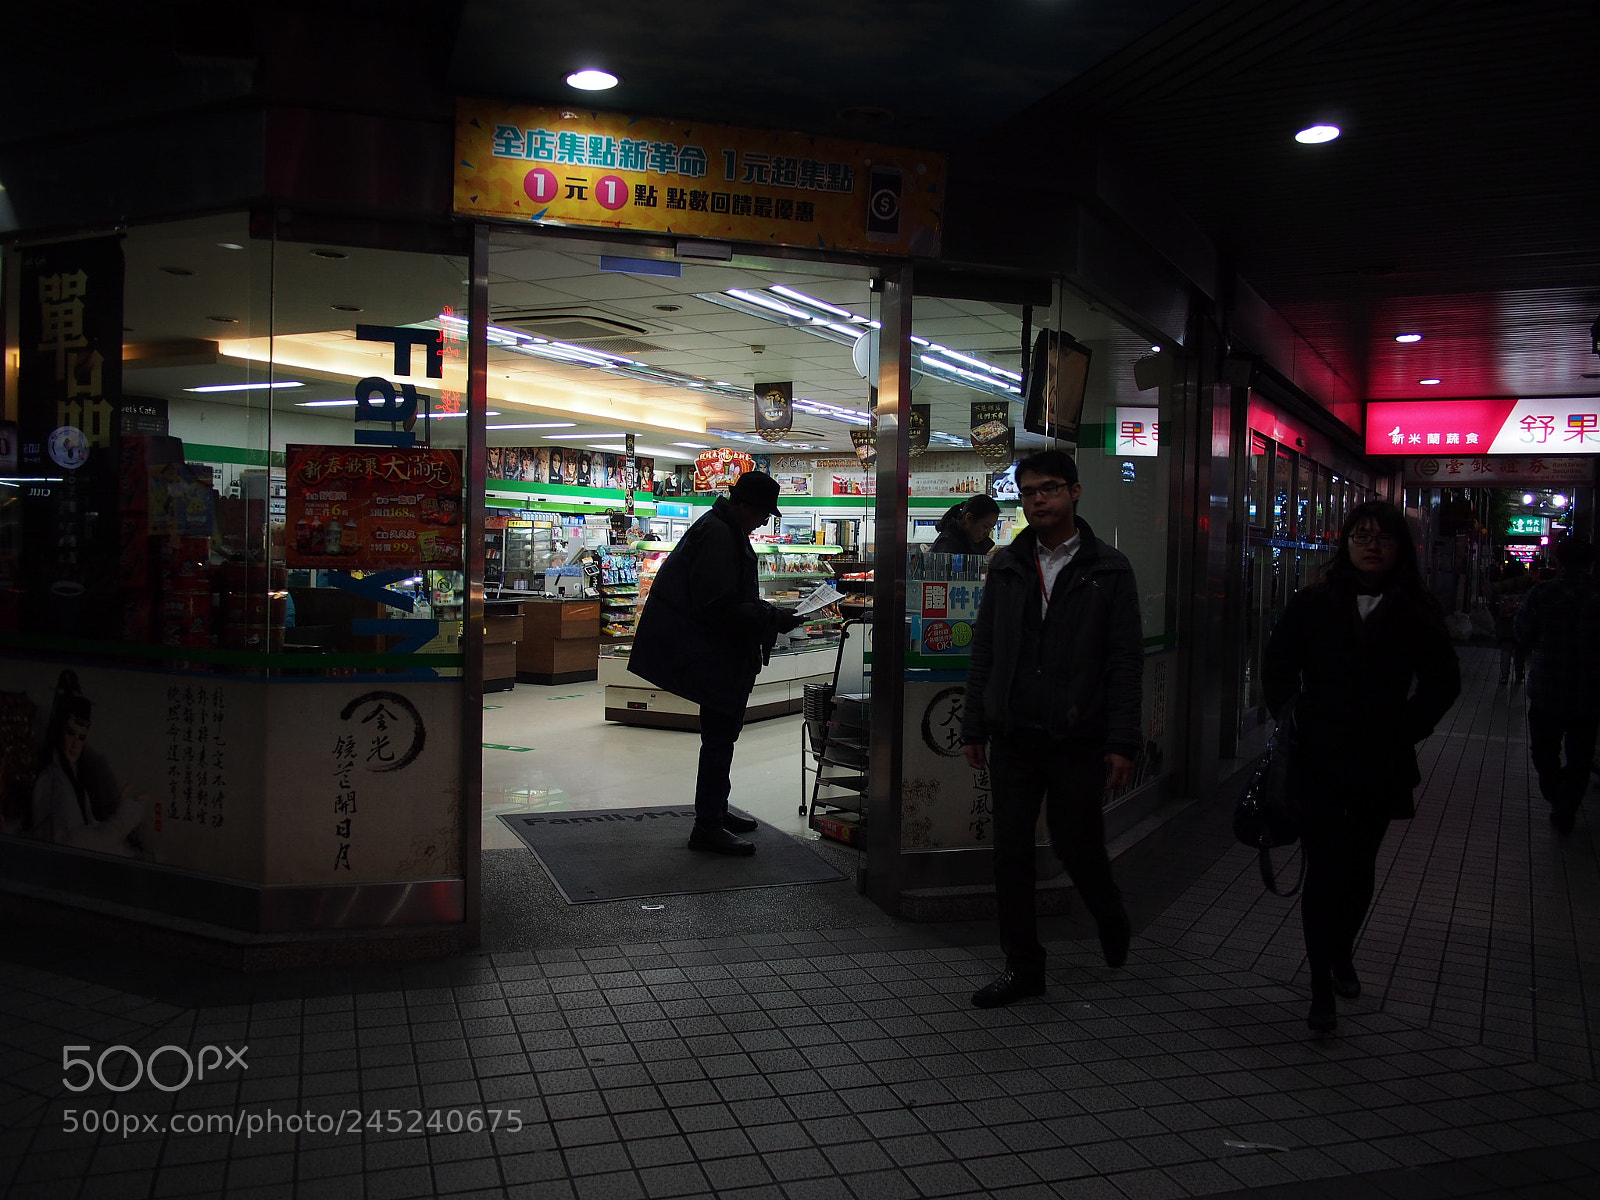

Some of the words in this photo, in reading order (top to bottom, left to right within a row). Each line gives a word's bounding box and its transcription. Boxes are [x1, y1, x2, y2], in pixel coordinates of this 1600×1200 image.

[492, 122, 707, 178] 全店集點新革命
[721, 149, 854, 194] 1元超集點
[666, 187, 815, 223] 點數回饋最優惠
[1391, 431, 1480, 445] 新米蘭蔬食
[1519, 414, 1600, 444] 舒果
